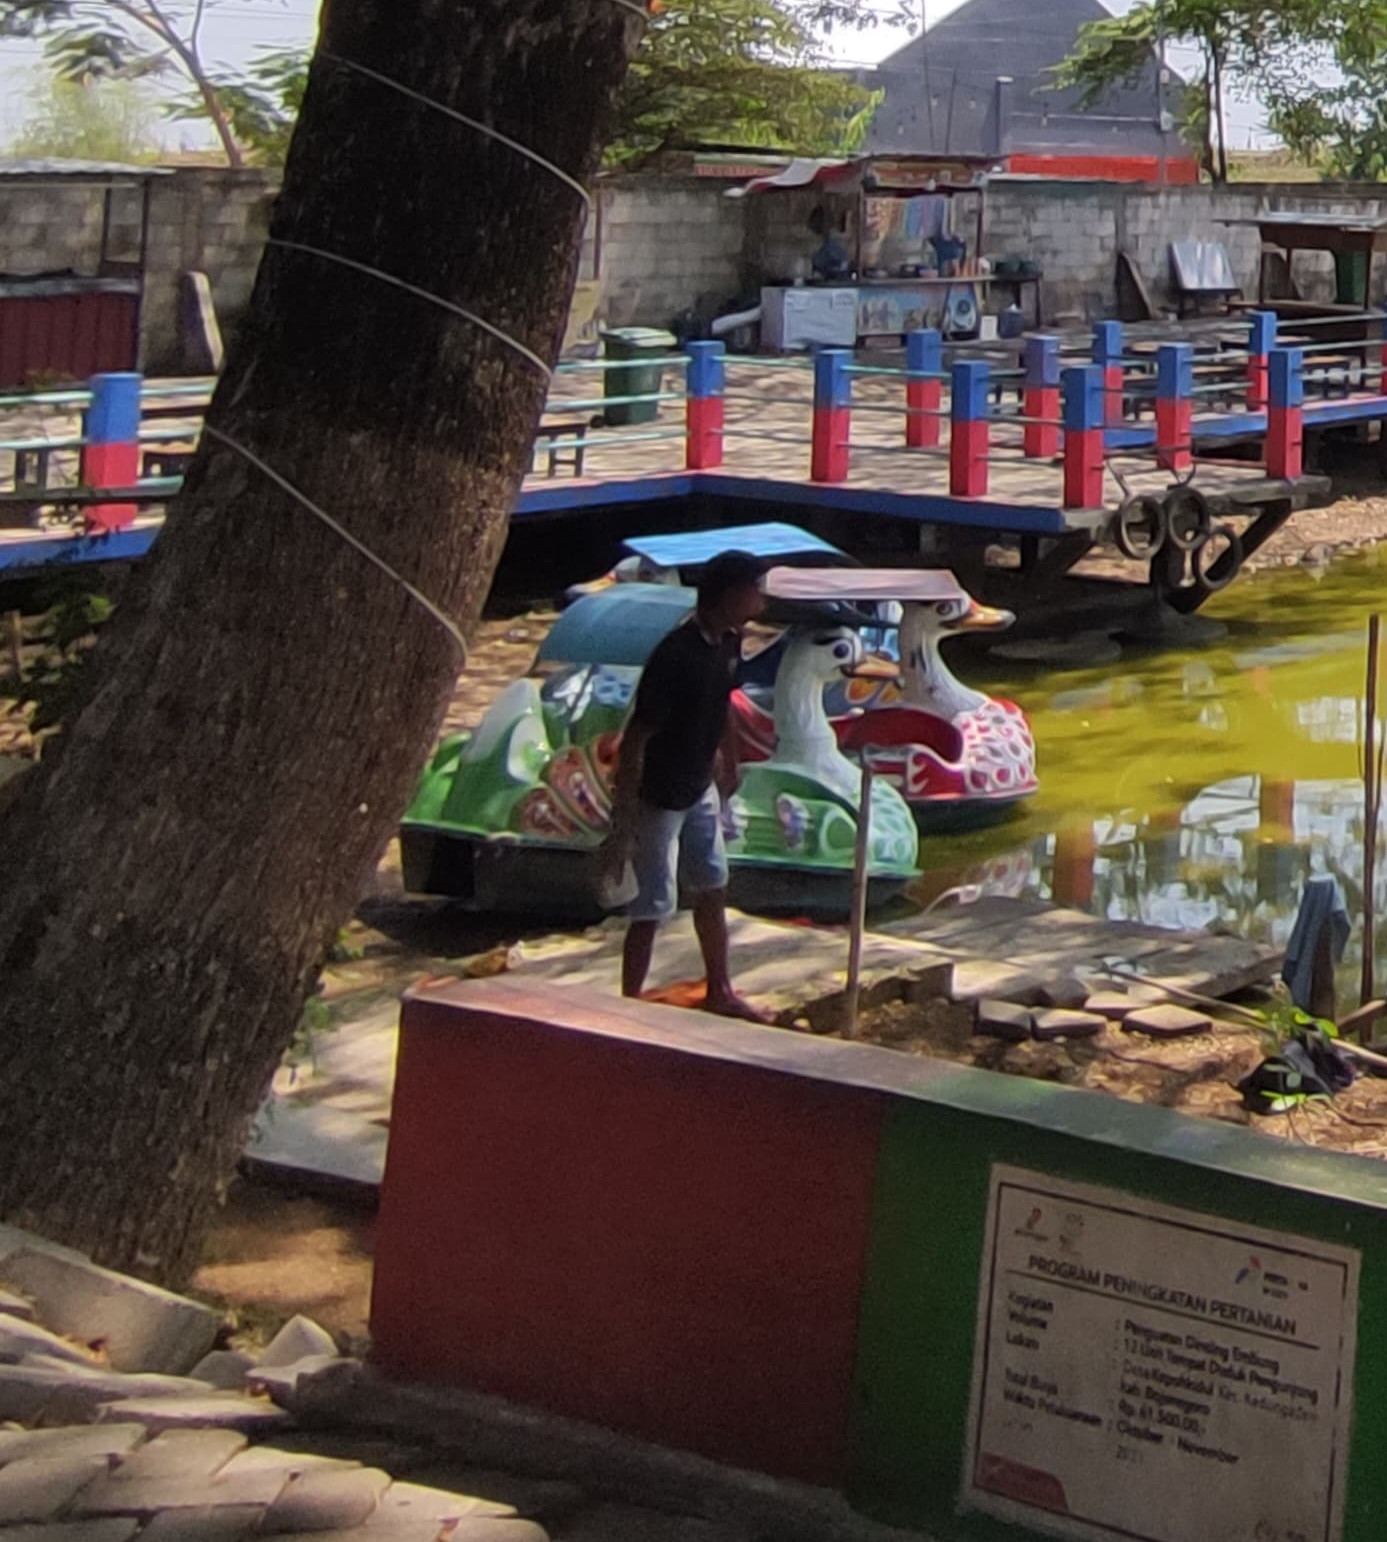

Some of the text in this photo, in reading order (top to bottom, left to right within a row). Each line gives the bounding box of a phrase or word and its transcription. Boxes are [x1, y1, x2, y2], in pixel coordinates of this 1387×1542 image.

[1028, 1255, 1297, 1336] PROGRAM PENINGKATAN PERTANIAN
[1124, 1337, 1138, 1354] 12
[1209, 1360, 1246, 1380] Duduk
[1177, 1434, 1241, 1464] November
